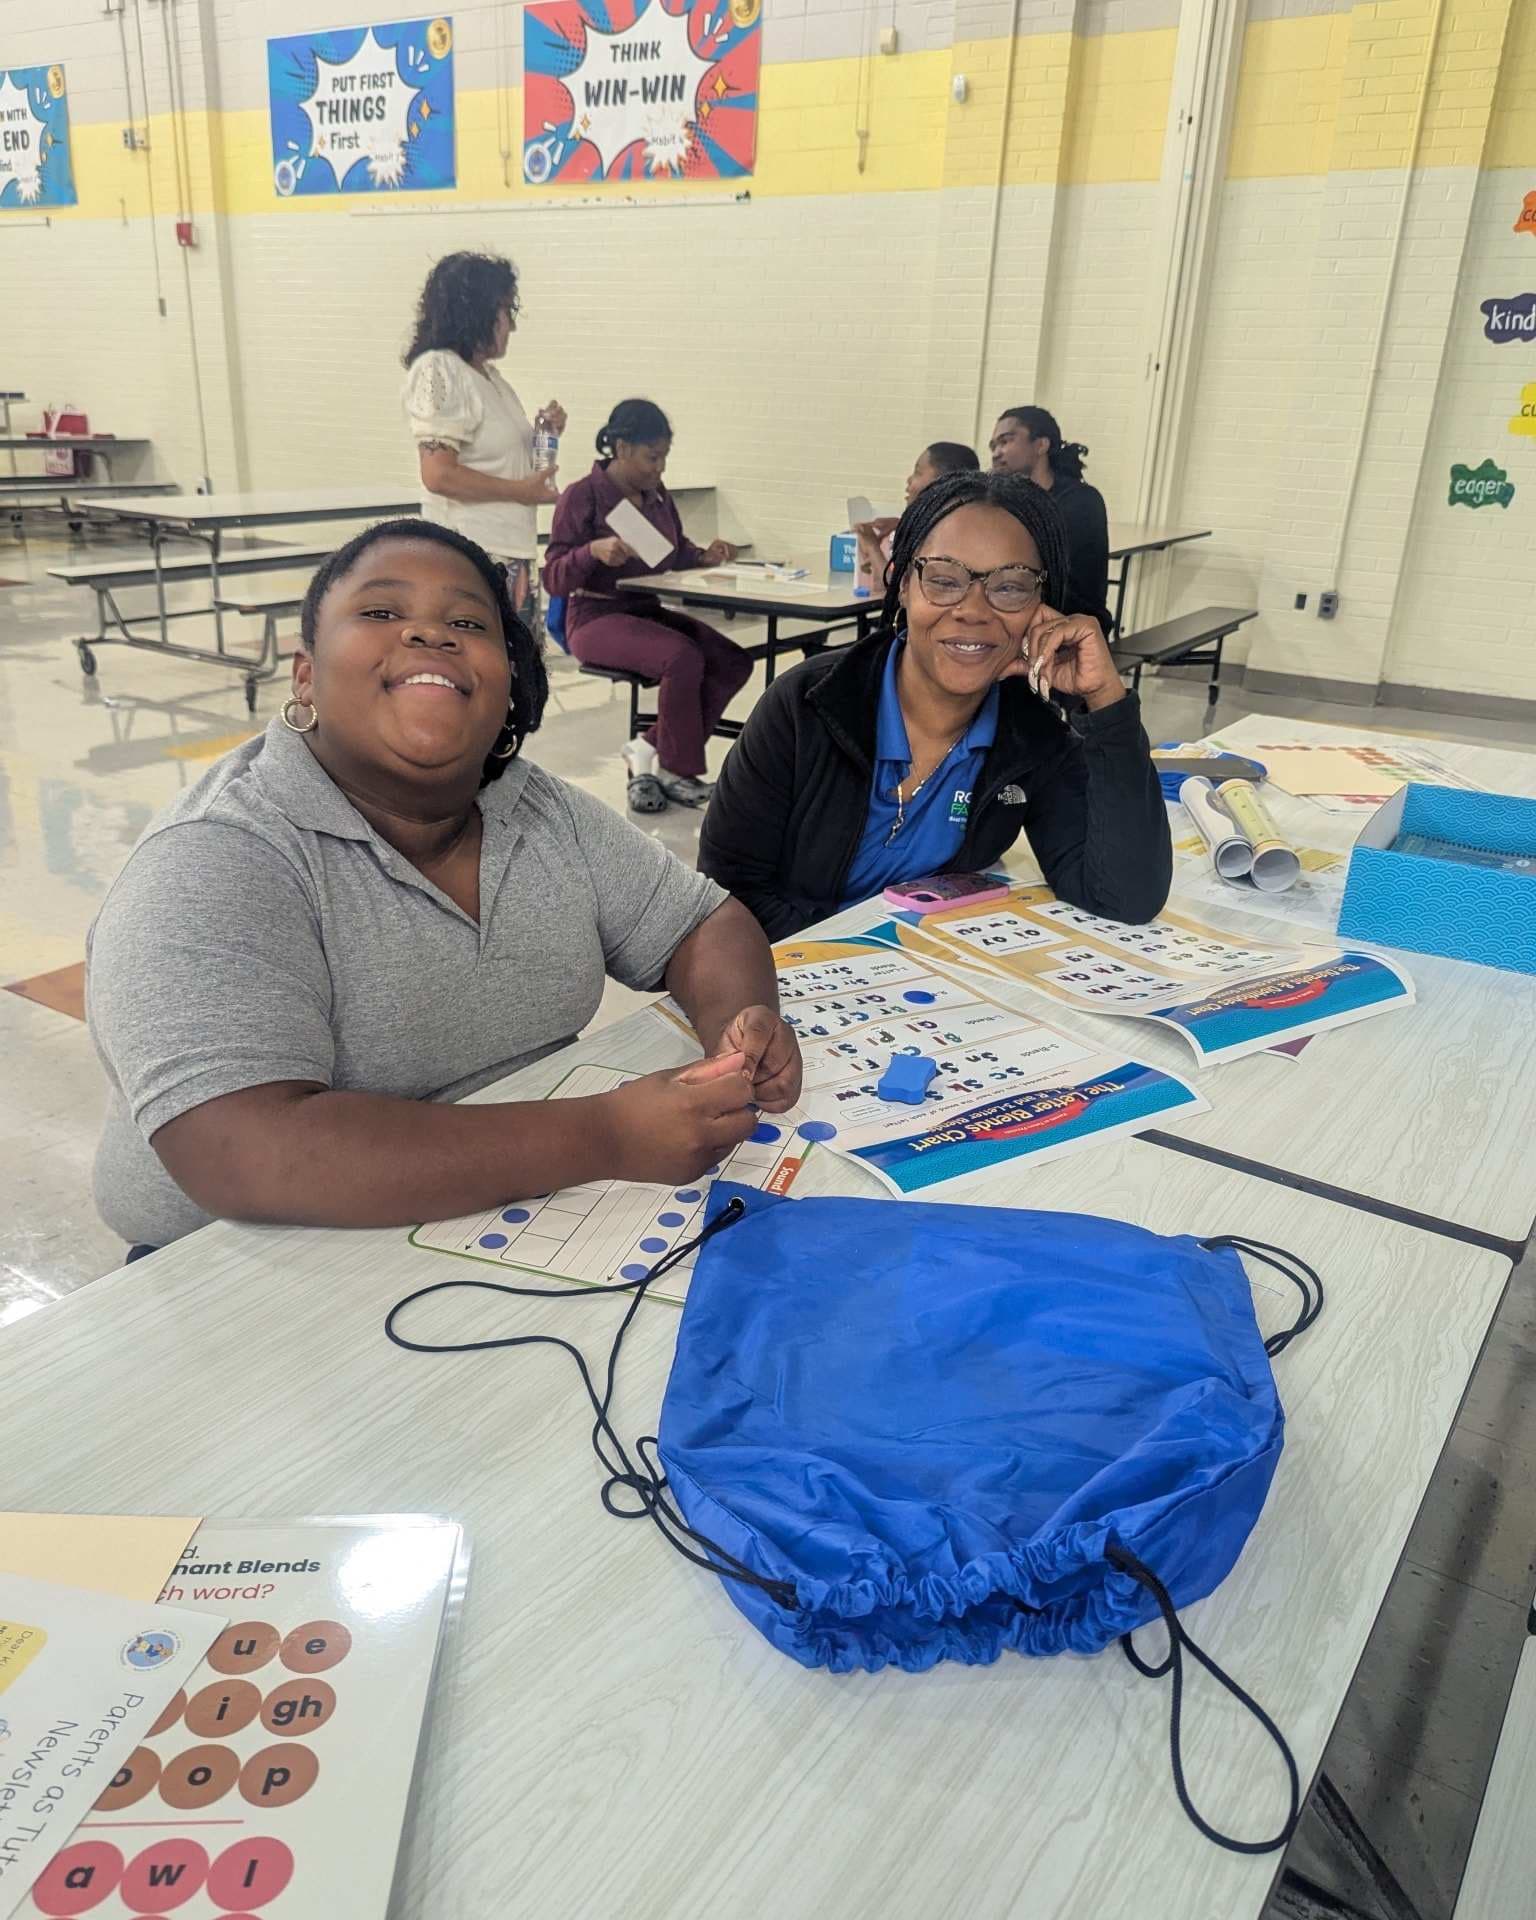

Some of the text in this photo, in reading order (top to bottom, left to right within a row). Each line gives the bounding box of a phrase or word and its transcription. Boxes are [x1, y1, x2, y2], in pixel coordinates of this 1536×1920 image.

[610, 41, 662, 63] THINK
[331, 71, 395, 93] PUT FIRST
[585, 75, 686, 107] WIN-WIN
[7, 108, 28, 120] WITH
[316, 96, 386, 124] THINGS
[4, 130, 30, 152] END
[330, 130, 361, 151] First
[1490, 304, 1536, 331] kind
[1454, 479, 1506, 504] eager
[1065, 953, 1094, 962] ng
[1056, 964, 1125, 982] Ph Gh
[1086, 985, 1122, 995] Wh
[813, 1002, 845, 1013] Pr
[854, 995, 886, 1005] Gr
[833, 1012, 869, 1027] Cr
[904, 1020, 937, 1032] Gl
[865, 1030, 895, 1047] Pl
[965, 1051, 998, 1063] Sn
[988, 1066, 1024, 1080] Sc
[947, 1079, 983, 1093] Sk
[923, 1090, 944, 1101] S
[1015, 1095, 1035, 1105] and
[908, 1082, 1125, 1152] The Letter Blends Chart
[771, 1166, 794, 1191] Sound
[237, 1558, 321, 1574] Blends
[193, 1583, 275, 1600] word?
[233, 1637, 326, 1655] u e
[216, 1696, 323, 1725] i gh
[61, 1692, 145, 1777] Parents
[187, 1766, 212, 1787] o
[262, 1765, 291, 1795] p
[32, 1785, 64, 1814] as
[64, 1866, 96, 1889] a
[149, 1863, 187, 1886] w
